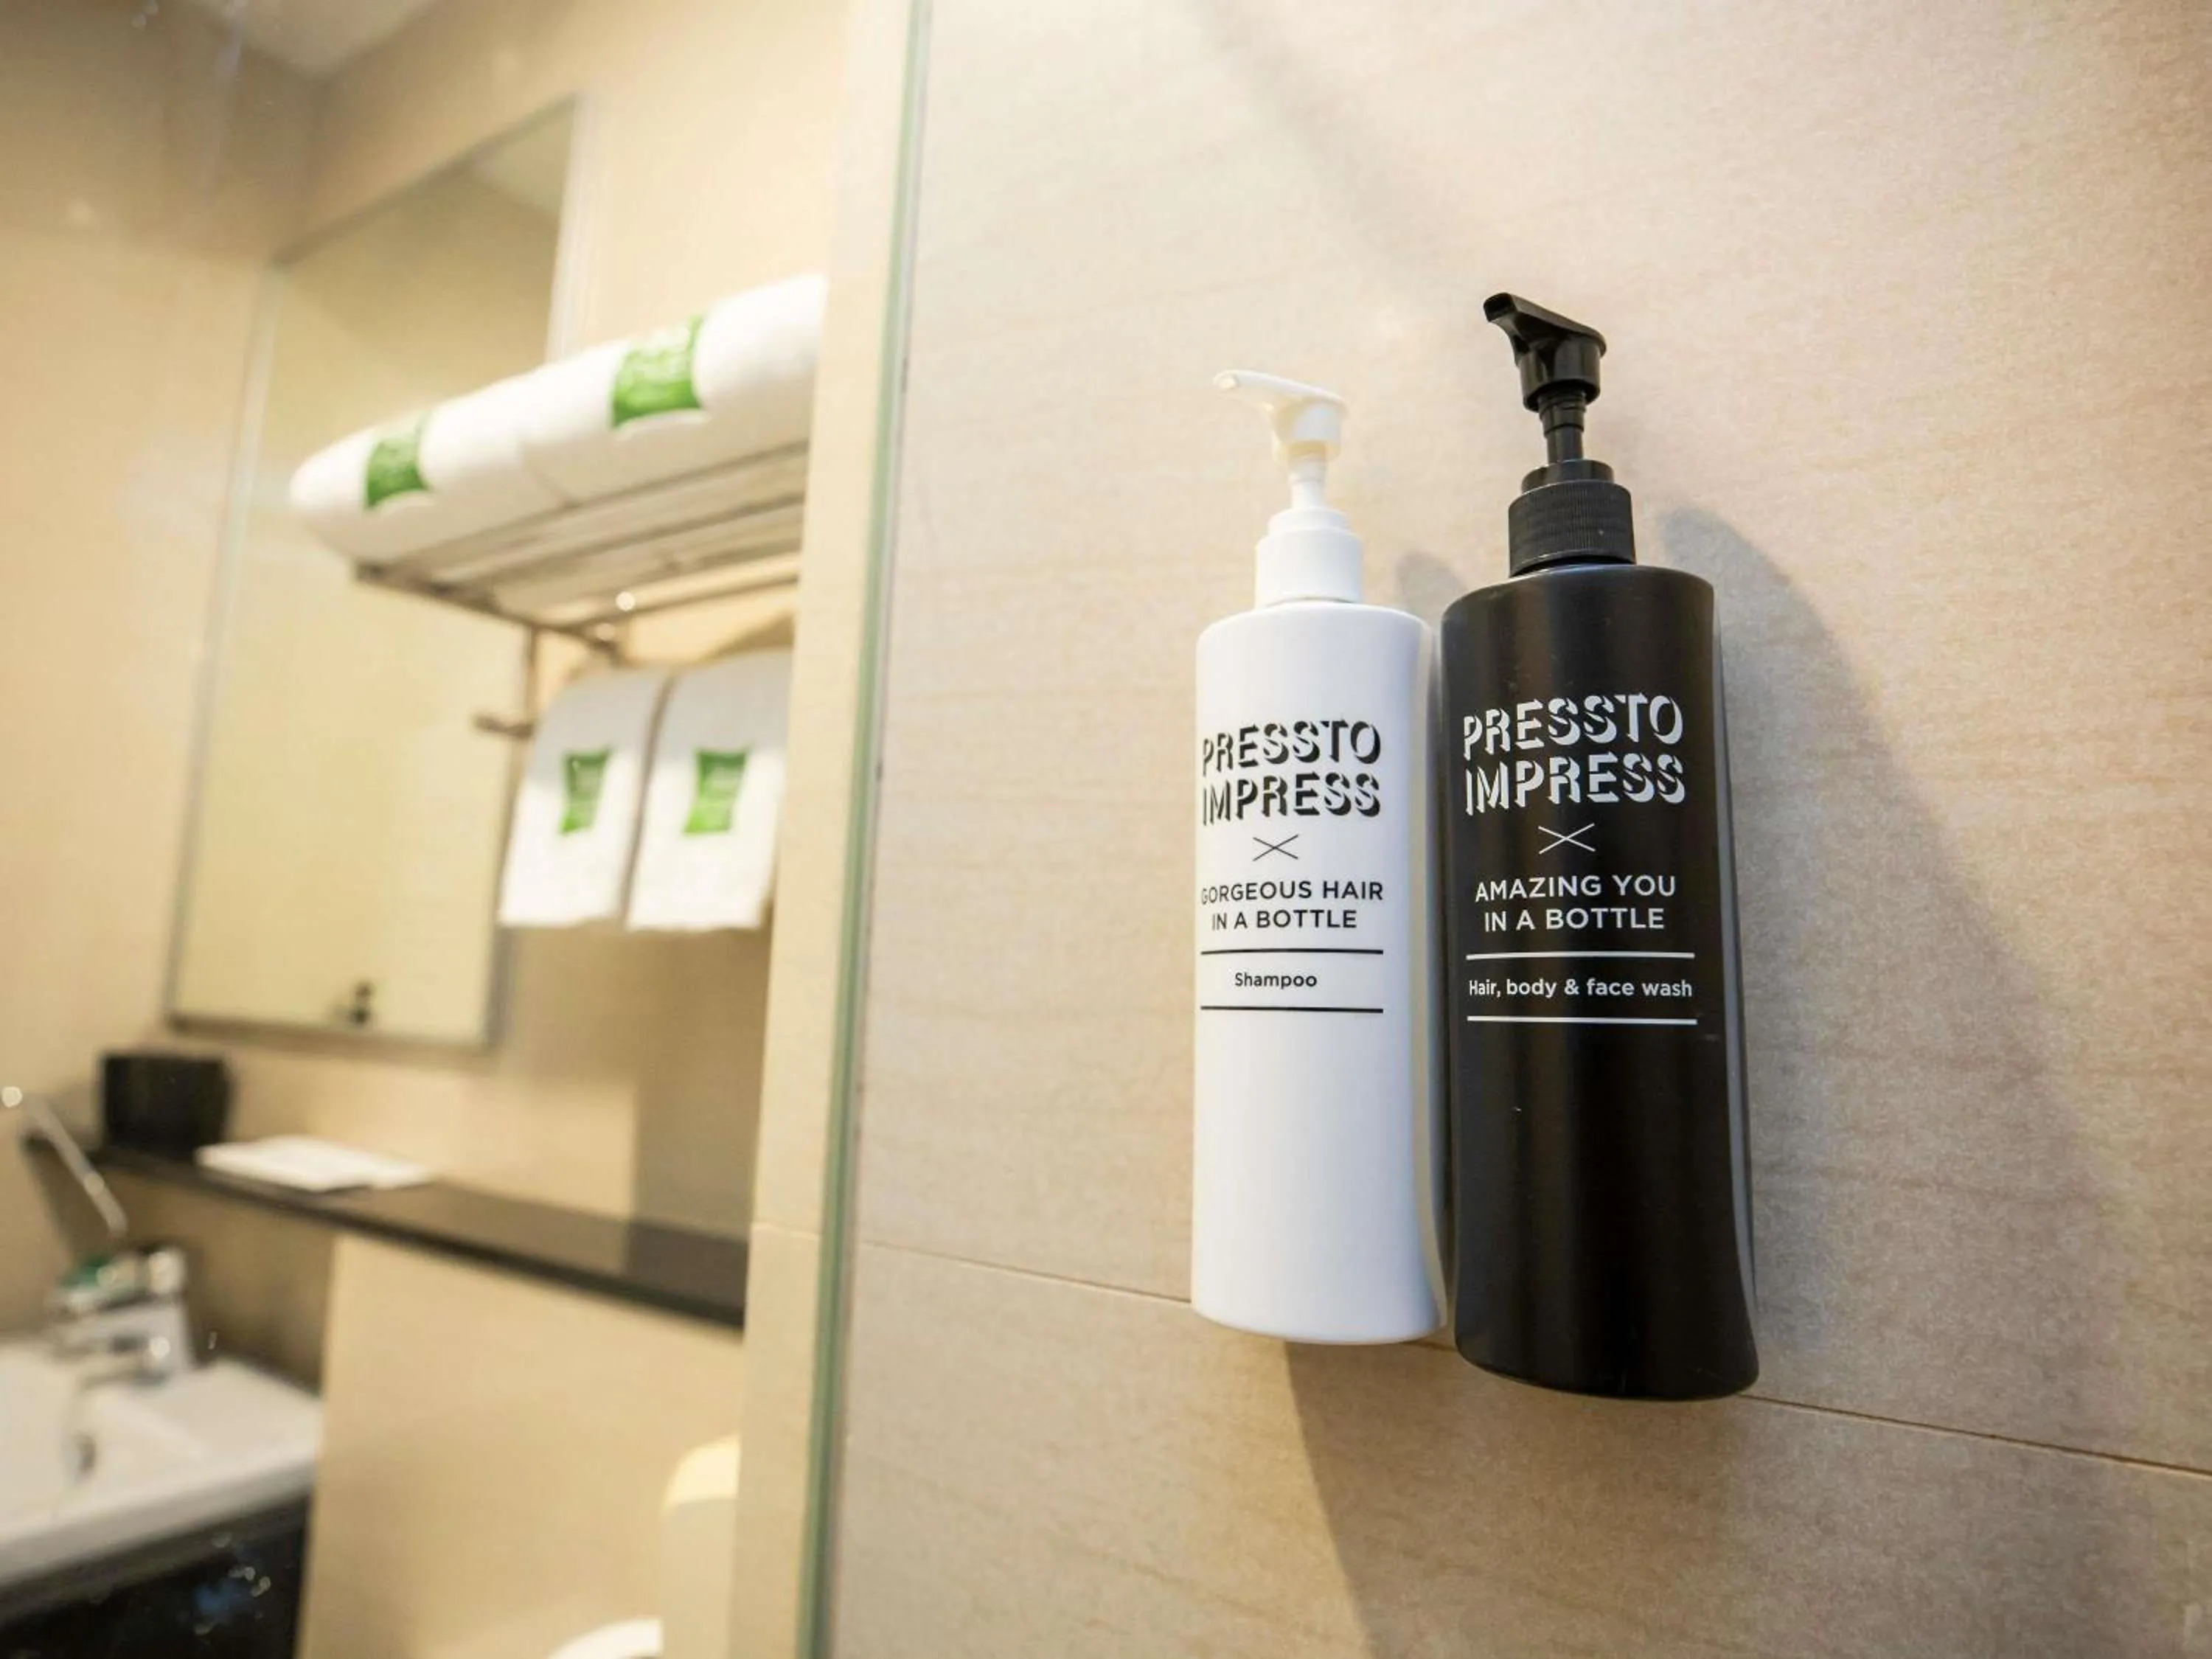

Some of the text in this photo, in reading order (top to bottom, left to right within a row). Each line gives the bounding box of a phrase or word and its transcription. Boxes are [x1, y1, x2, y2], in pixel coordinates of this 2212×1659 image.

[1463, 692, 1684, 761] PRESSTO
[1203, 719, 1382, 776] PRESSTO
[1464, 751, 1686, 816] IMPRESS
[1203, 771, 1382, 826] IMPRESS
[1201, 880, 1384, 905] GORGEOUS HAIR
[1475, 874, 1677, 903] AMAZING YOU
[1211, 909, 1357, 931] IN A BOTTLE
[1484, 908, 1665, 933] IN A BOTTLE
[1234, 972, 1318, 990] Shampoo
[1469, 978, 1694, 999] Hair, body & face wash
